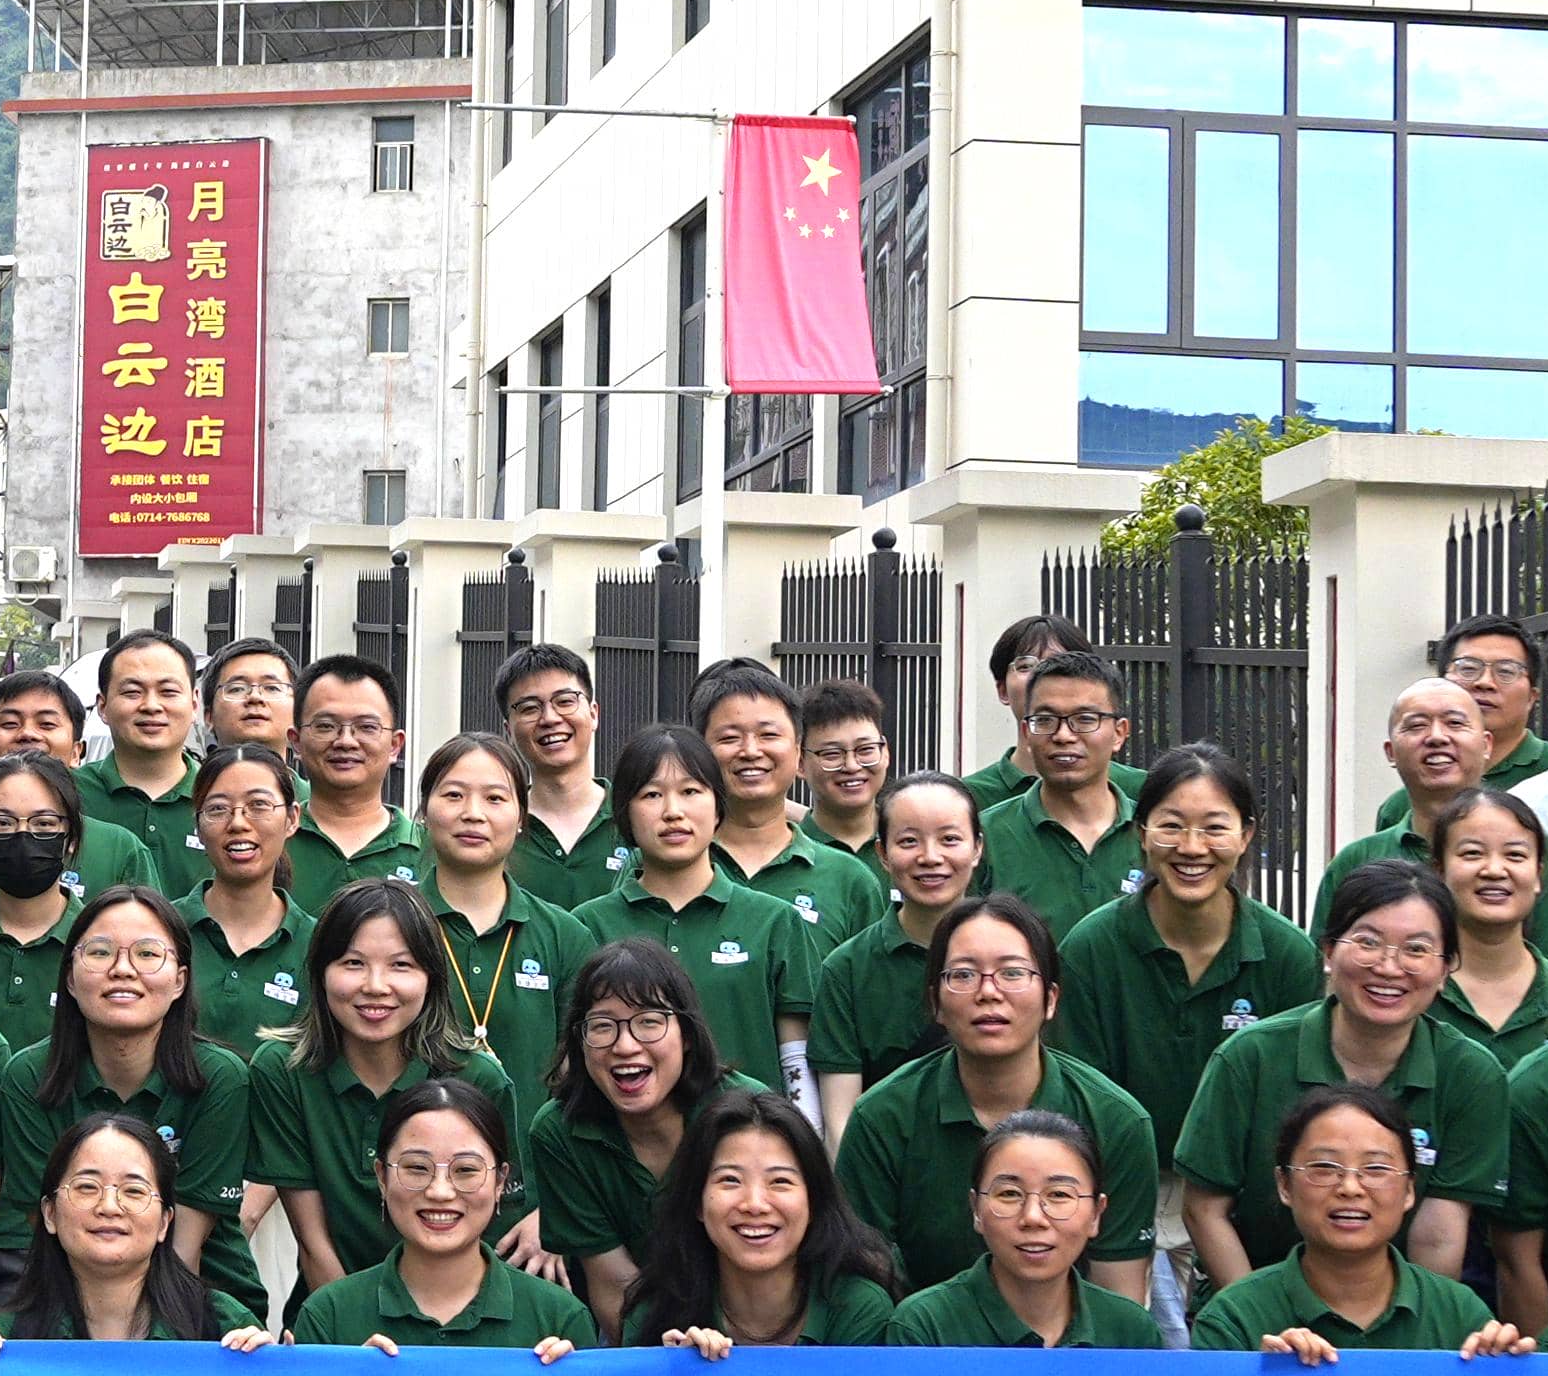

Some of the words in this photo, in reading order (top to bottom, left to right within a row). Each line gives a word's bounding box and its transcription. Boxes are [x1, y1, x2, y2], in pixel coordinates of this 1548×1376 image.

[107, 197, 133, 253] 白云边
[182, 180, 228, 457] 月亮湾酒店
[100, 271, 169, 457] 白云边
[110, 473, 156, 486] 承接团体
[160, 473, 183, 486] 餐饮
[187, 473, 210, 486] 住宿
[130, 492, 198, 505] 内设大小包厢
